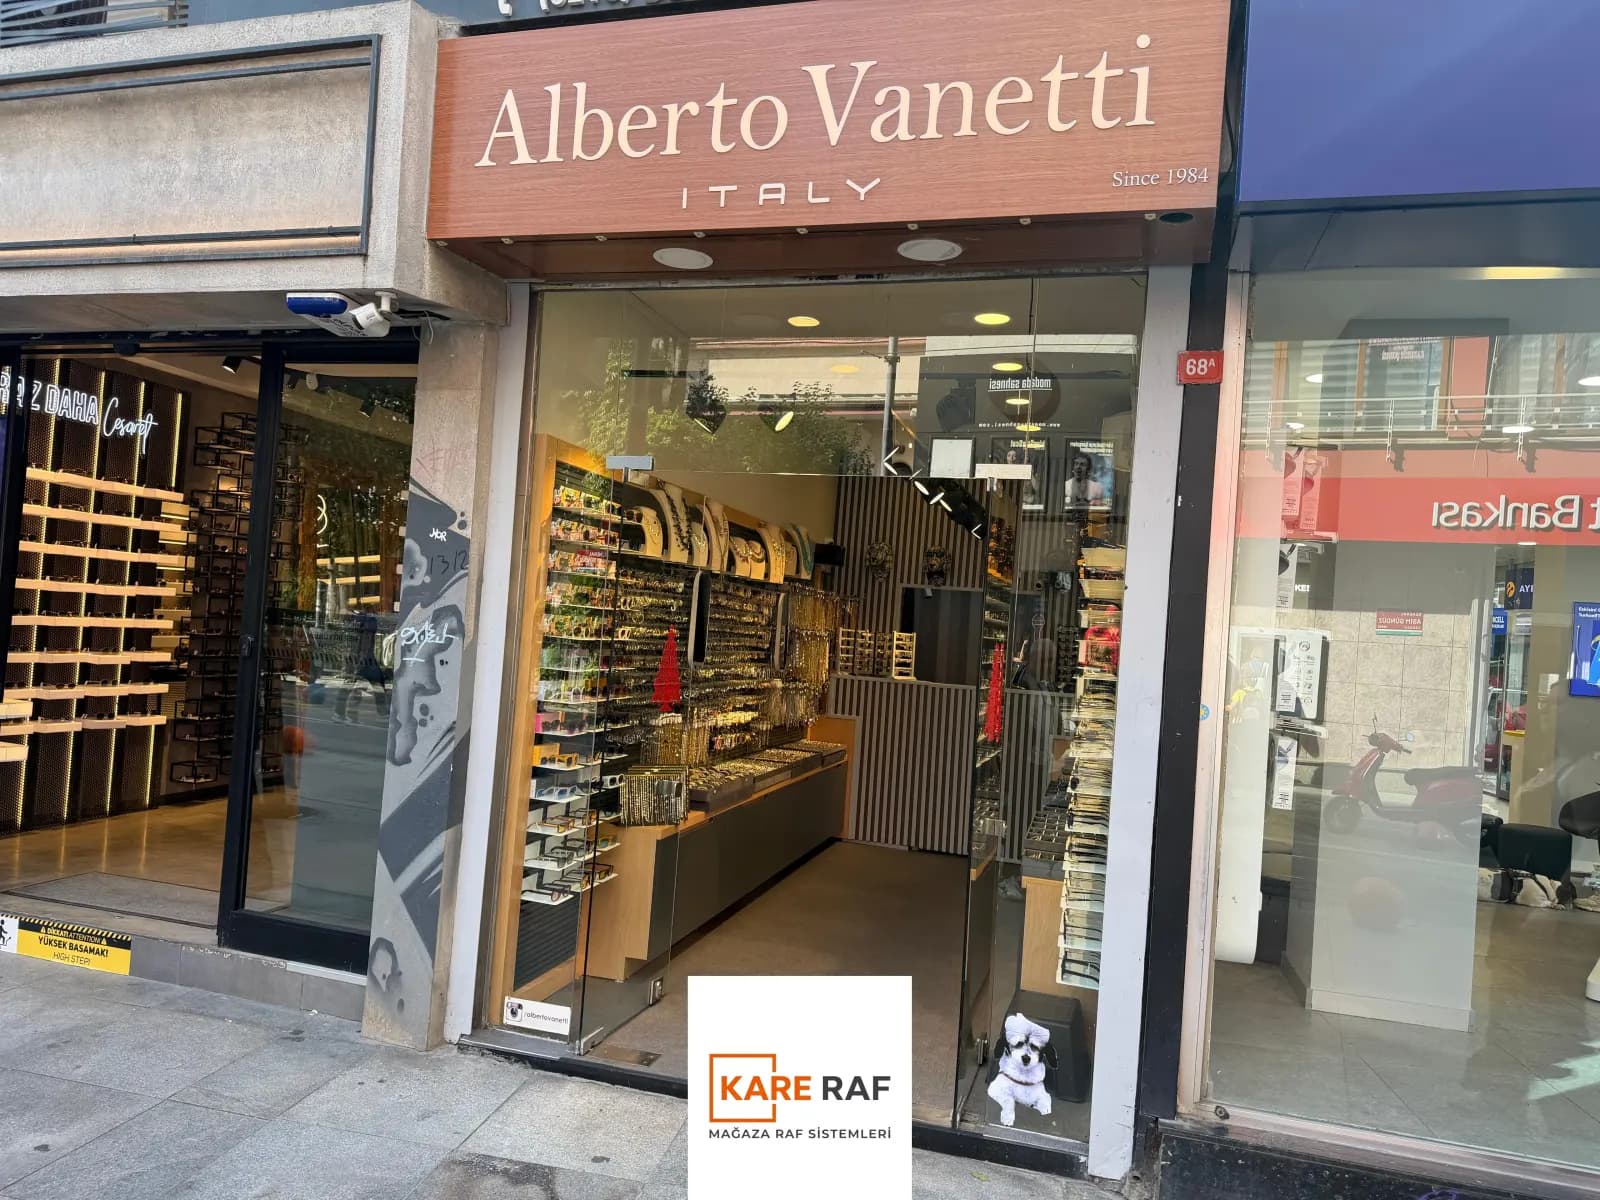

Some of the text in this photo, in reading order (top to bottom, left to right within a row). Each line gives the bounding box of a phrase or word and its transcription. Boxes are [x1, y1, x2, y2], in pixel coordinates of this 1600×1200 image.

[474, 33, 1156, 168] Alberto Vanetti
[1112, 167, 1209, 187] Since 1984
[682, 177, 880, 209] ITALY
[45, 384, 99, 425] DAHA
[38, 935, 108, 957] YÜKSEK BASAMAK!
[53, 951, 70, 962] HIGH
